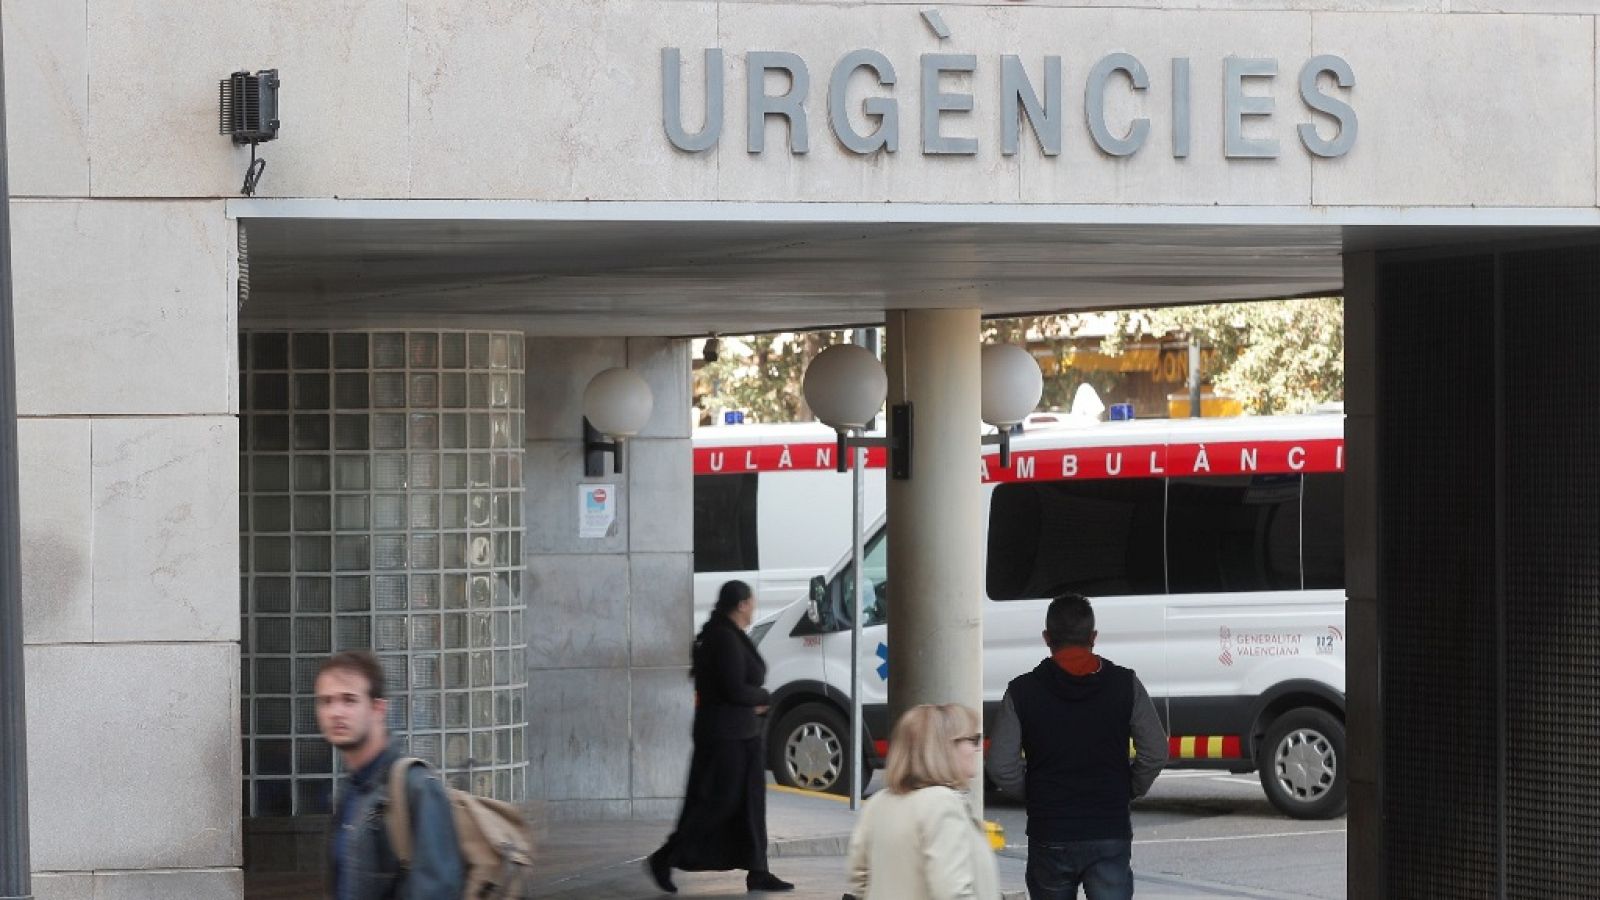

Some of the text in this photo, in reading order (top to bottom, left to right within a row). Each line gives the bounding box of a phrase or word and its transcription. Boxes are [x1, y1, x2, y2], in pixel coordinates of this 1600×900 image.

[660, 9, 1358, 158] URGÈNCIES
[1236, 632, 1303, 645] GENERALITAT
[1316, 635, 1334, 647] 112
[1236, 646, 1300, 657] VALENCIANA
